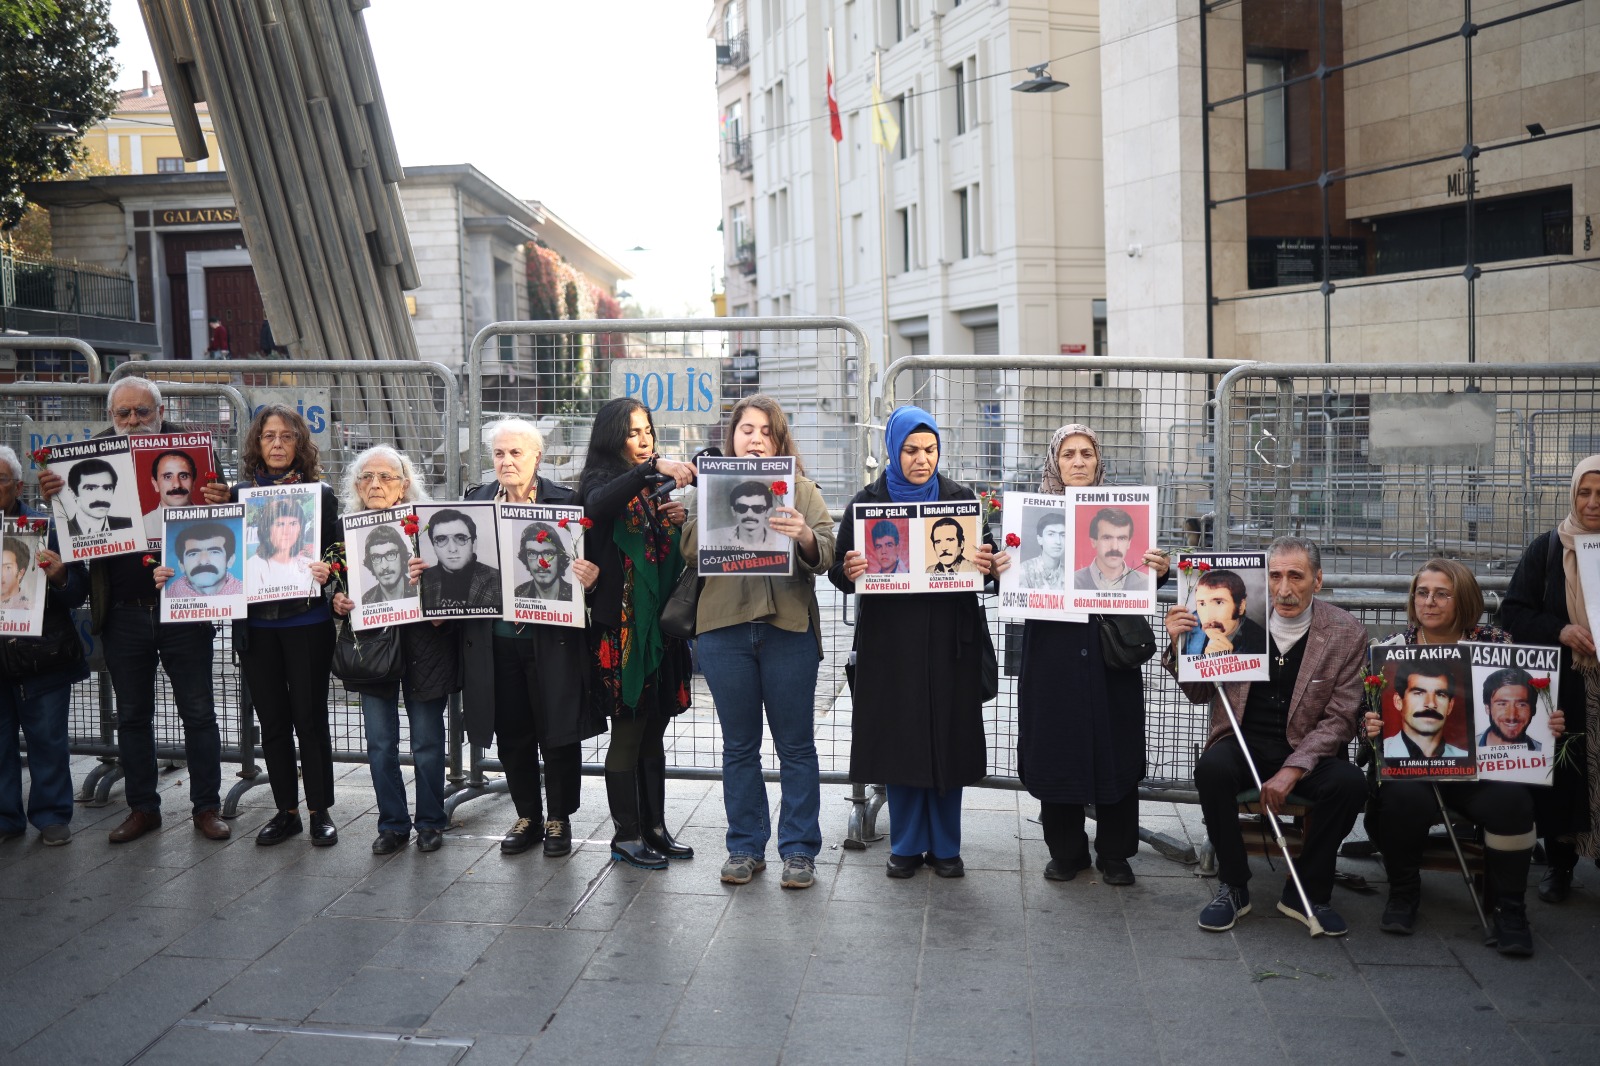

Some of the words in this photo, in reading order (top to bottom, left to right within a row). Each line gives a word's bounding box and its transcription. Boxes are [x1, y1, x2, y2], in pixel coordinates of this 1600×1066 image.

[1448, 168, 1480, 197] MÜE
[624, 367, 714, 412] POLİS
[98, 438, 128, 452] CİHAN
[131, 438, 169, 448] KENAN
[171, 433, 210, 446] BİLGİN
[702, 461, 757, 471] HAYRETTİN
[761, 461, 789, 470] EREN
[250, 488, 288, 498] SEDİKA
[290, 487, 310, 495] DAL
[1075, 491, 1110, 502] FEHMİ
[1112, 492, 1150, 502] TOSUN
[1023, 497, 1057, 507] FERHAT
[1058, 500, 1066, 508] T
[166, 507, 209, 521] İBRAHİM
[211, 504, 243, 518] DEMİR
[501, 506, 553, 520] HAYRETTİN
[555, 509, 581, 521] EREN
[865, 507, 884, 517] EDİP
[885, 507, 908, 519] ÇELİK
[923, 505, 955, 515] İBRAHİM
[956, 504, 977, 516] ÇELİK
[345, 511, 393, 529] HAYRETTİN
[72, 538, 108, 549] GÖZALTINDA
[72, 538, 136, 559] KAYBEDİLDİ
[702, 552, 758, 566] GÖZALTINDA
[721, 554, 787, 572] KAYBEDİLDİ
[1215, 557, 1261, 568] KIRBAYIR
[865, 581, 910, 591] KAYBEDİLDİ
[929, 579, 974, 589] KAYBEDİLDİ
[170, 602, 208, 610] GÖZALTINDA
[515, 602, 547, 611] GÖZALTINDA
[1073, 597, 1112, 609] GÖZALTINDA
[1112, 597, 1149, 609] KAYBEDİLDİ
[170, 604, 232, 619] KAYBEDİLDİ
[362, 606, 394, 616] GÖZALTINDA
[363, 606, 420, 626] KAYBEDİLDİ
[425, 607, 464, 616] NURETTİN
[465, 605, 498, 615] YEDİGÖL
[515, 609, 573, 623] KAYBEDİLDİ
[1385, 646, 1417, 661] AGİT
[1419, 646, 1462, 660] AKİPA
[1471, 646, 1511, 667] ASAN
[1515, 649, 1556, 670] OCAK
[1194, 655, 1239, 670] GÖZALTINDA
[1200, 658, 1261, 679] KAYBEDİLDİ
[1381, 766, 1428, 776] GÖZALTINDA
[1429, 765, 1476, 776] KAYBEDİLDİ
